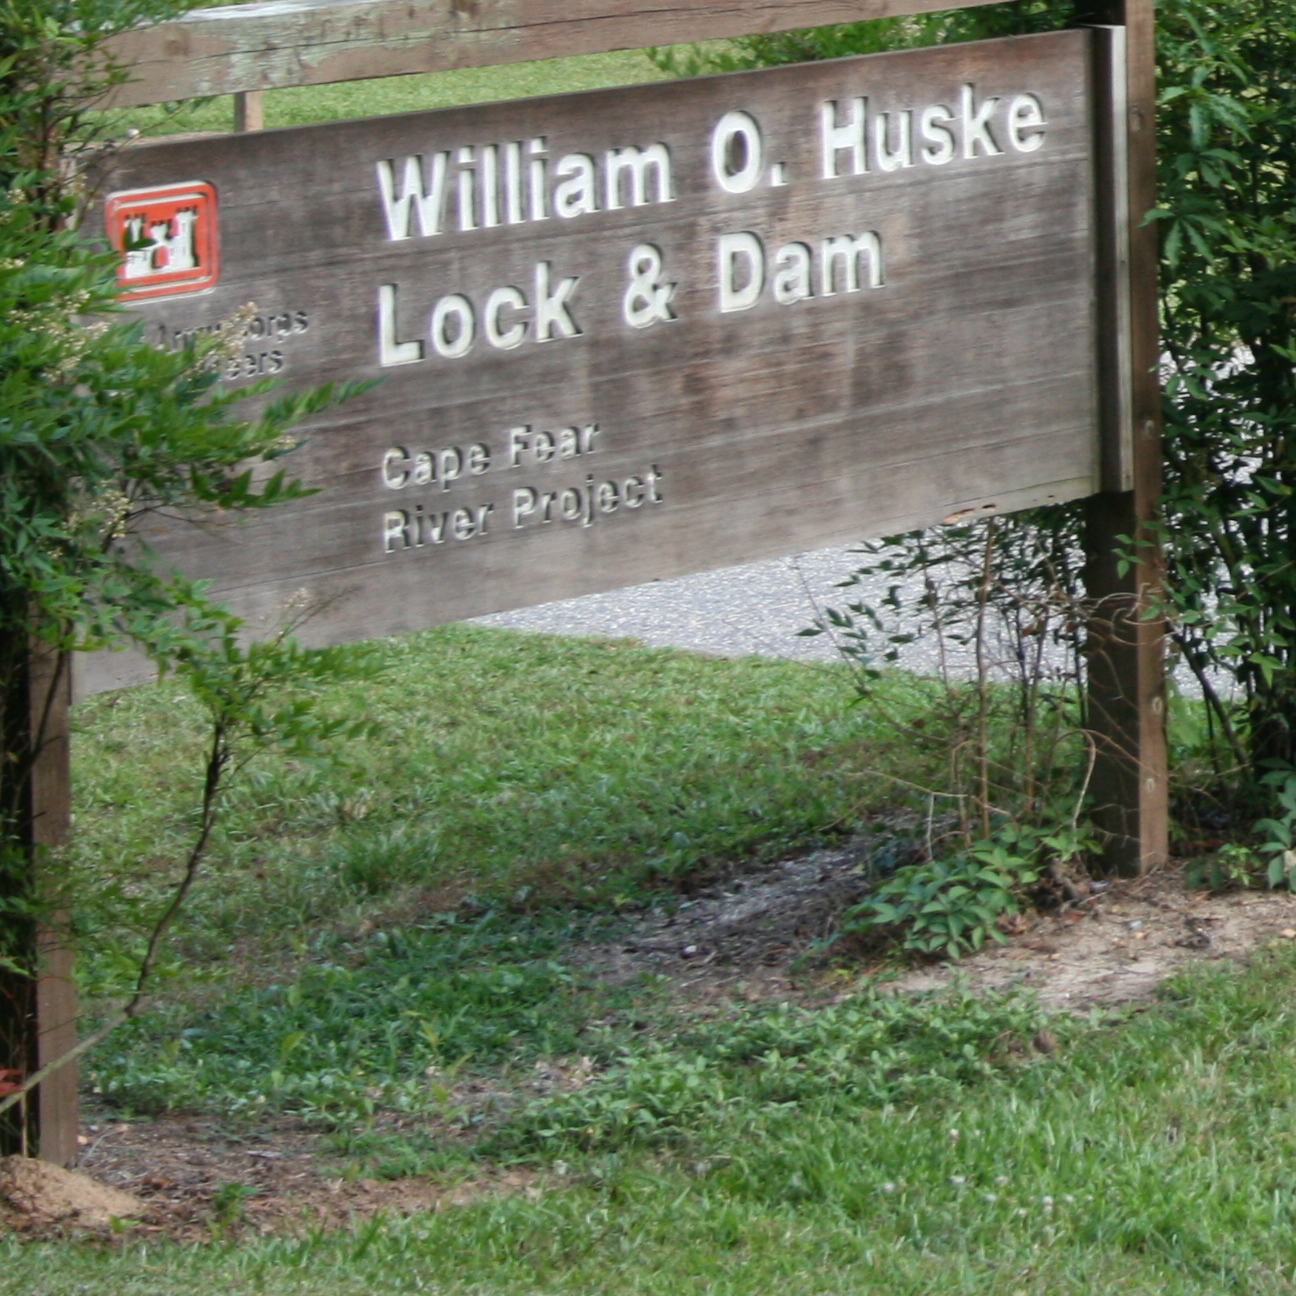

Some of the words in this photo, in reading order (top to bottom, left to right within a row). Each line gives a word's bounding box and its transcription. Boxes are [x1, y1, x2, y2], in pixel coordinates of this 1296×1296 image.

[376, 135, 677, 241] William
[712, 109, 788, 194] O.
[821, 81, 1048, 180] Huske
[238, 309, 309, 344] orps
[379, 260, 584, 368] Lock
[623, 242, 679, 329] &
[718, 229, 887, 314] Dam
[381, 442, 492, 493] Cape
[510, 422, 601, 468] Fear
[383, 504, 495, 554] River
[512, 463, 664, 529] Project
